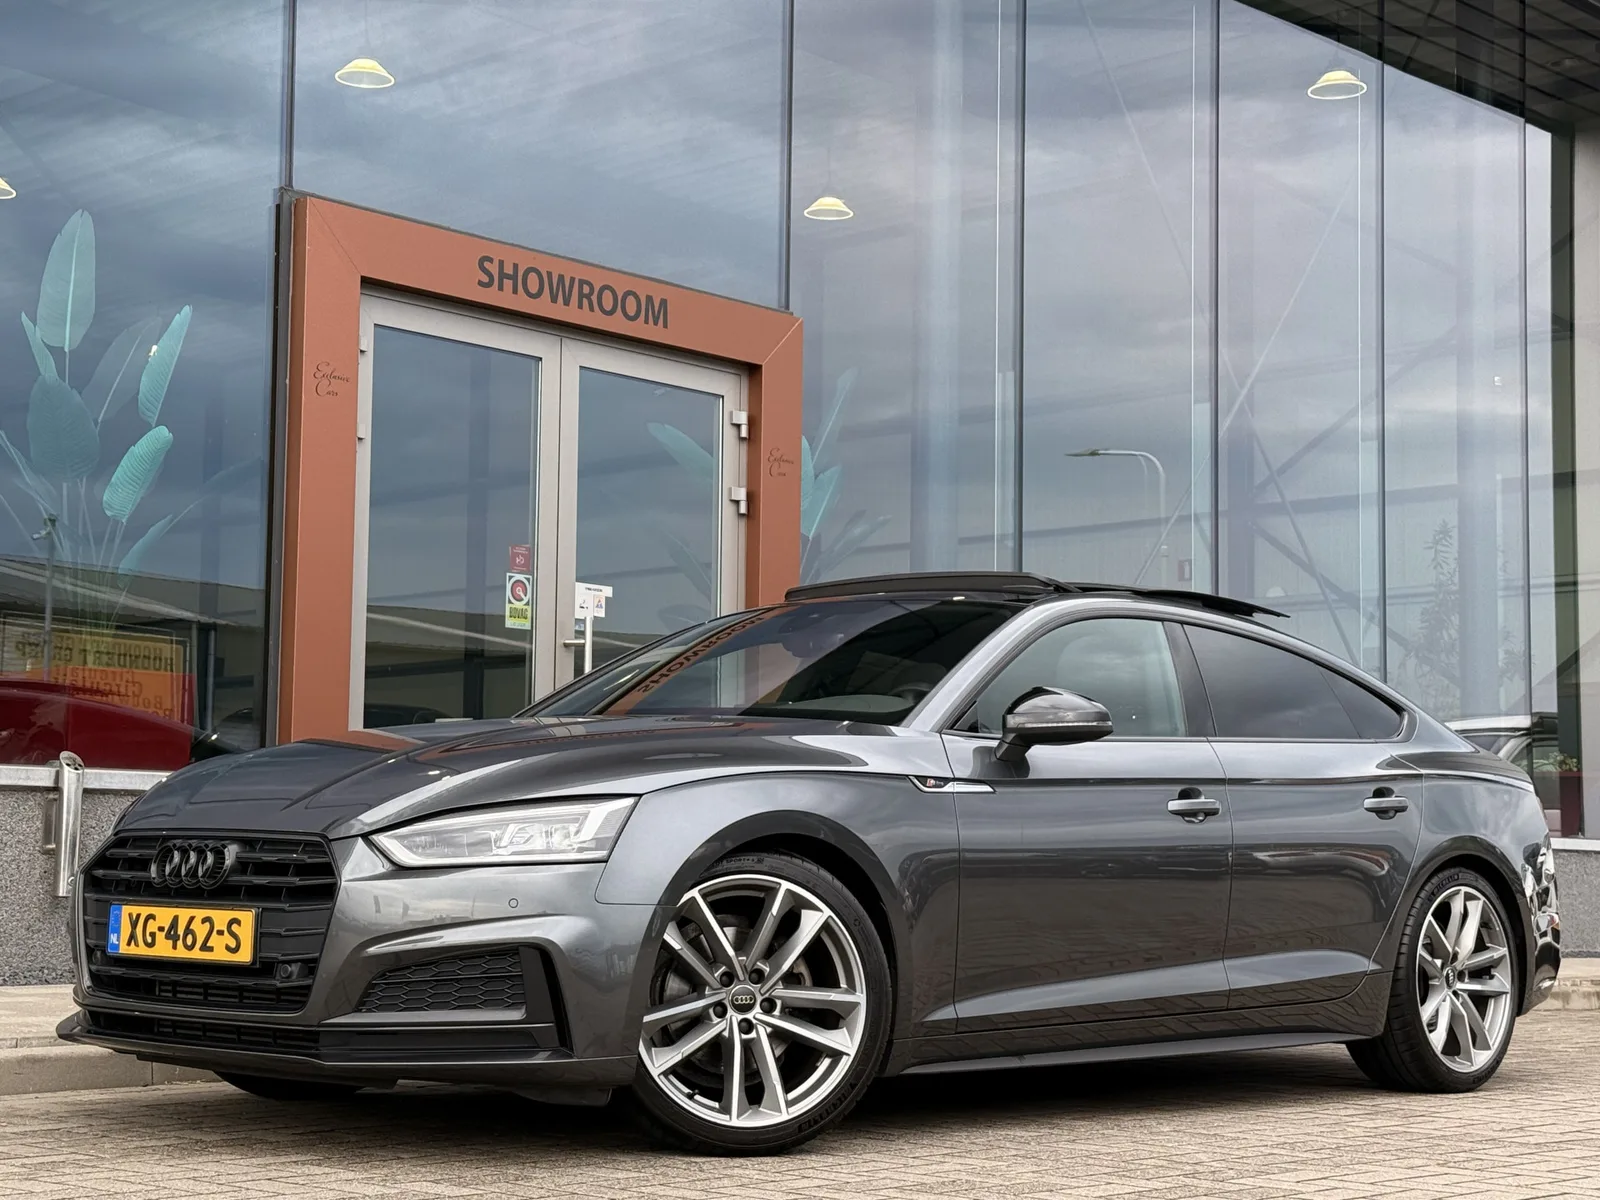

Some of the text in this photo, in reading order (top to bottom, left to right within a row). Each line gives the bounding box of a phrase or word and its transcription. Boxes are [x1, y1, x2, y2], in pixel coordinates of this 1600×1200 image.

[477, 255, 668, 329] SHOWROOM
[509, 606, 528, 620] BOVAG
[110, 932, 119, 944] NL
[126, 912, 242, 954] XG-462-S
